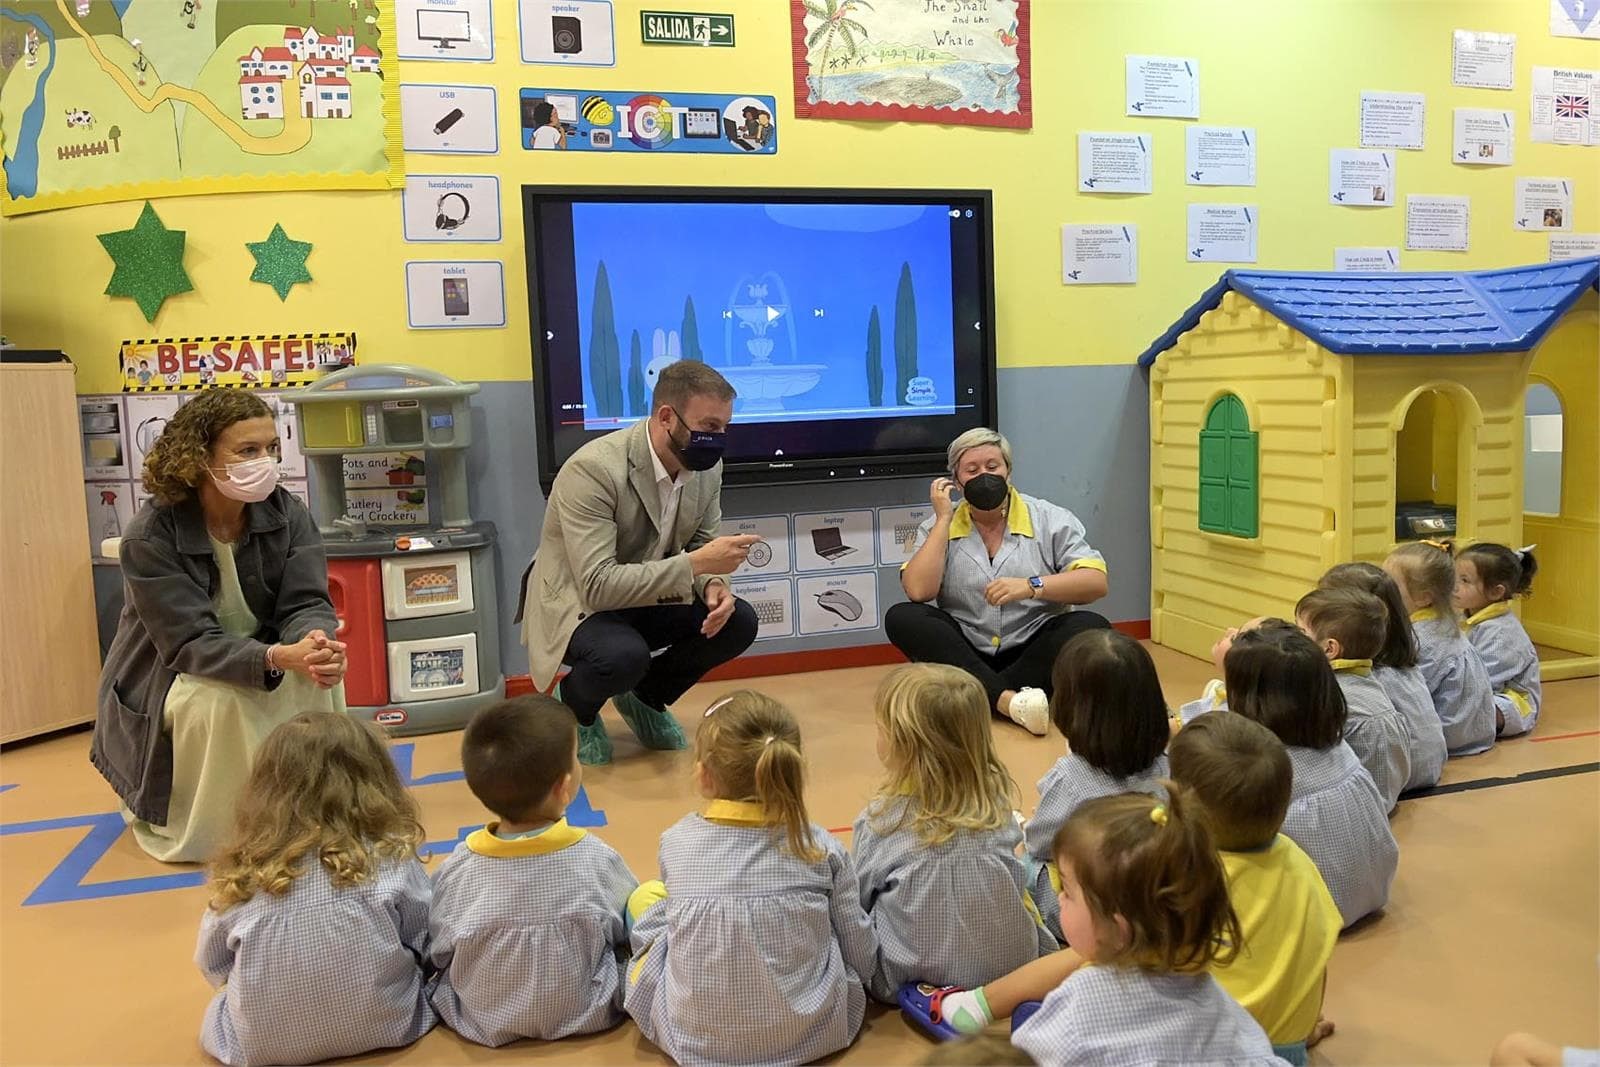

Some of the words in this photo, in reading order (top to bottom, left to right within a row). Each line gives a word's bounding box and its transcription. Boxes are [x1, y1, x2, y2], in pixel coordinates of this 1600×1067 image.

[552, 5, 579, 13] speaker
[953, 0, 987, 13] Snail
[952, 16, 969, 24] and
[648, 17, 691, 40] SALIDA
[933, 30, 974, 46] Whale
[439, 91, 455, 99] USB
[616, 105, 688, 139] ICT
[428, 180, 473, 190] headphones
[443, 267, 466, 275] tablet
[157, 343, 201, 374] BE
[213, 340, 315, 373] SAFE!
[342, 458, 364, 468] Pots
[368, 456, 388, 467] and
[343, 470, 367, 480] Pans
[369, 511, 416, 523] Crockery
[824, 517, 844, 525] laptop
[735, 584, 766, 594] keyboard
